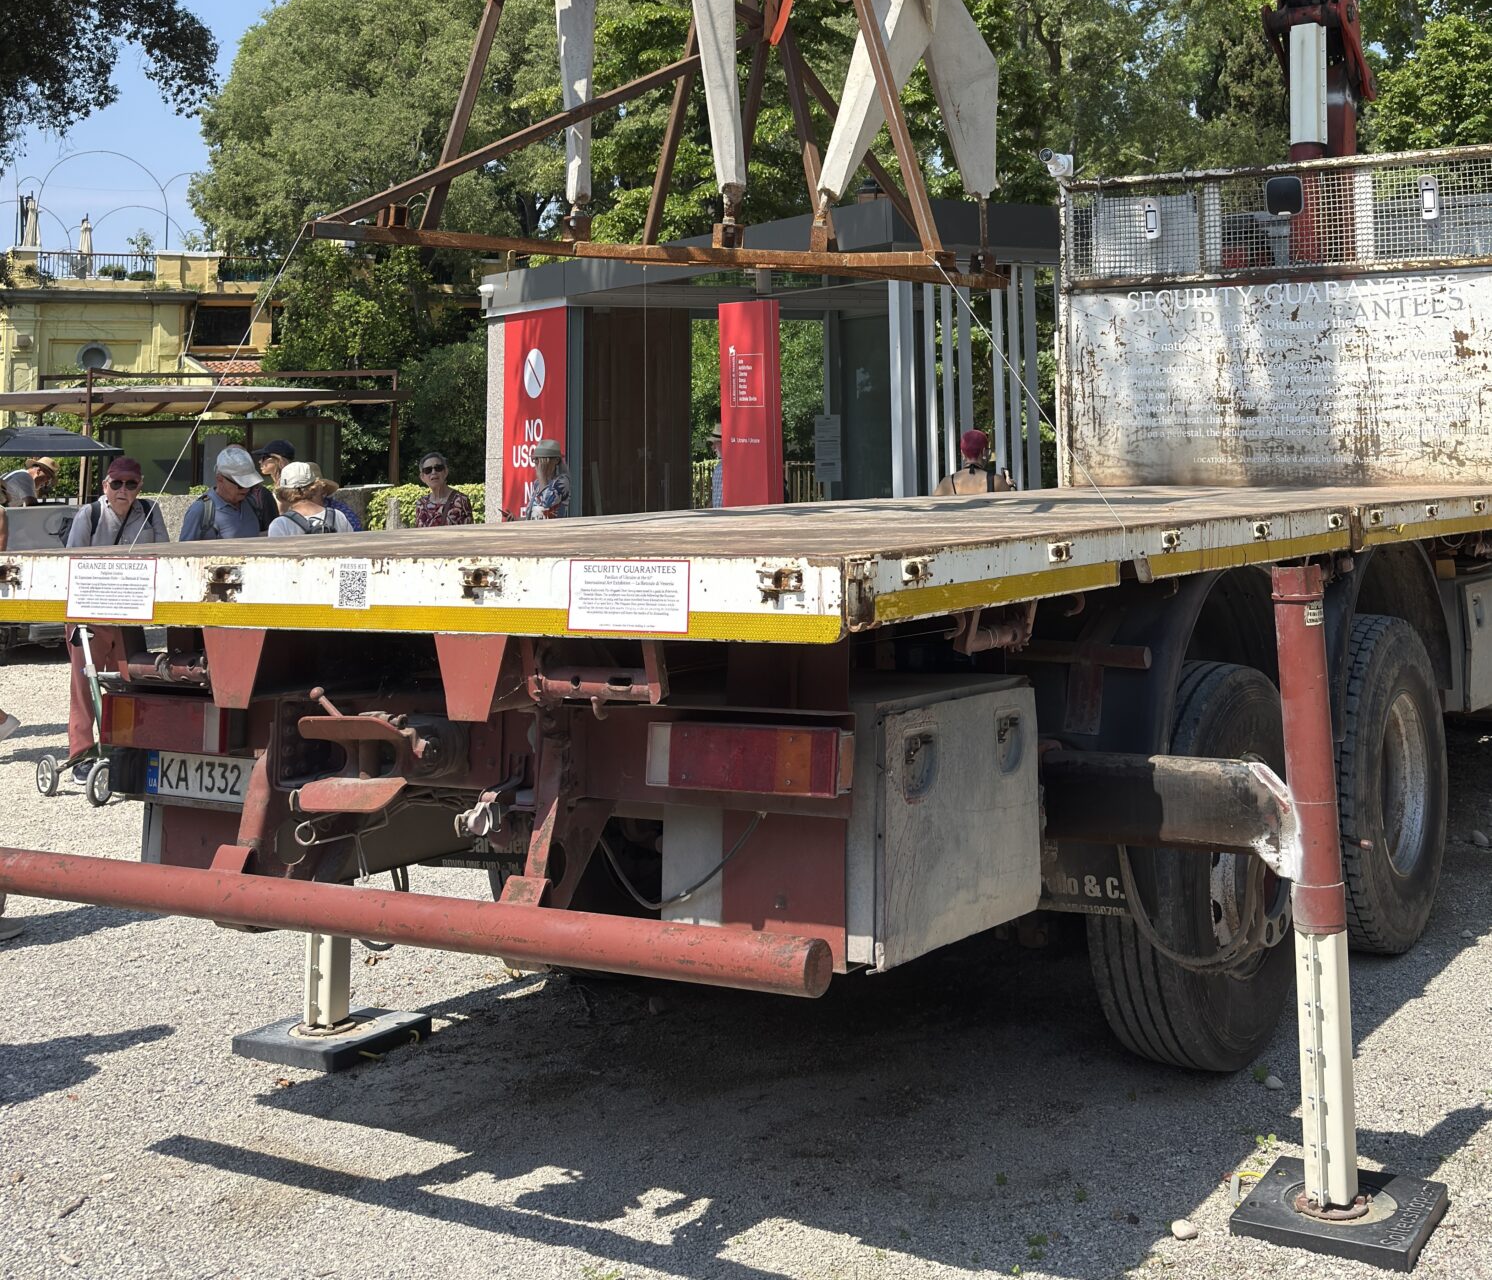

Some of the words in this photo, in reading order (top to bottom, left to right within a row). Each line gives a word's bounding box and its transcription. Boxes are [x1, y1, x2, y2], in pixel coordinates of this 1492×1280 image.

[1127, 285, 1255, 312] SECURITY
[1264, 273, 1459, 306] GUARANTEES
[1265, 318, 1315, 331] Ukraine
[1332, 316, 1352, 328] the
[1281, 412, 1321, 425] Hanging
[525, 418, 543, 443] NO
[1206, 427, 1221, 437] the
[1266, 426, 1284, 436] still
[1285, 425, 1313, 436] bears
[1317, 424, 1329, 435] the
[1275, 453, 1291, 464] Sale
[77, 562, 107, 570] GARANZIE
[108, 562, 114, 570] DI
[115, 562, 148, 571] SICUREZZA
[583, 564, 622, 574] SECURITY
[623, 565, 677, 574] GUARANTEES
[148, 778, 157, 787] UA
[160, 756, 189, 791] KA
[194, 760, 242, 796] 1332
[1084, 873, 1102, 898] &
[1105, 876, 1126, 900] C.
